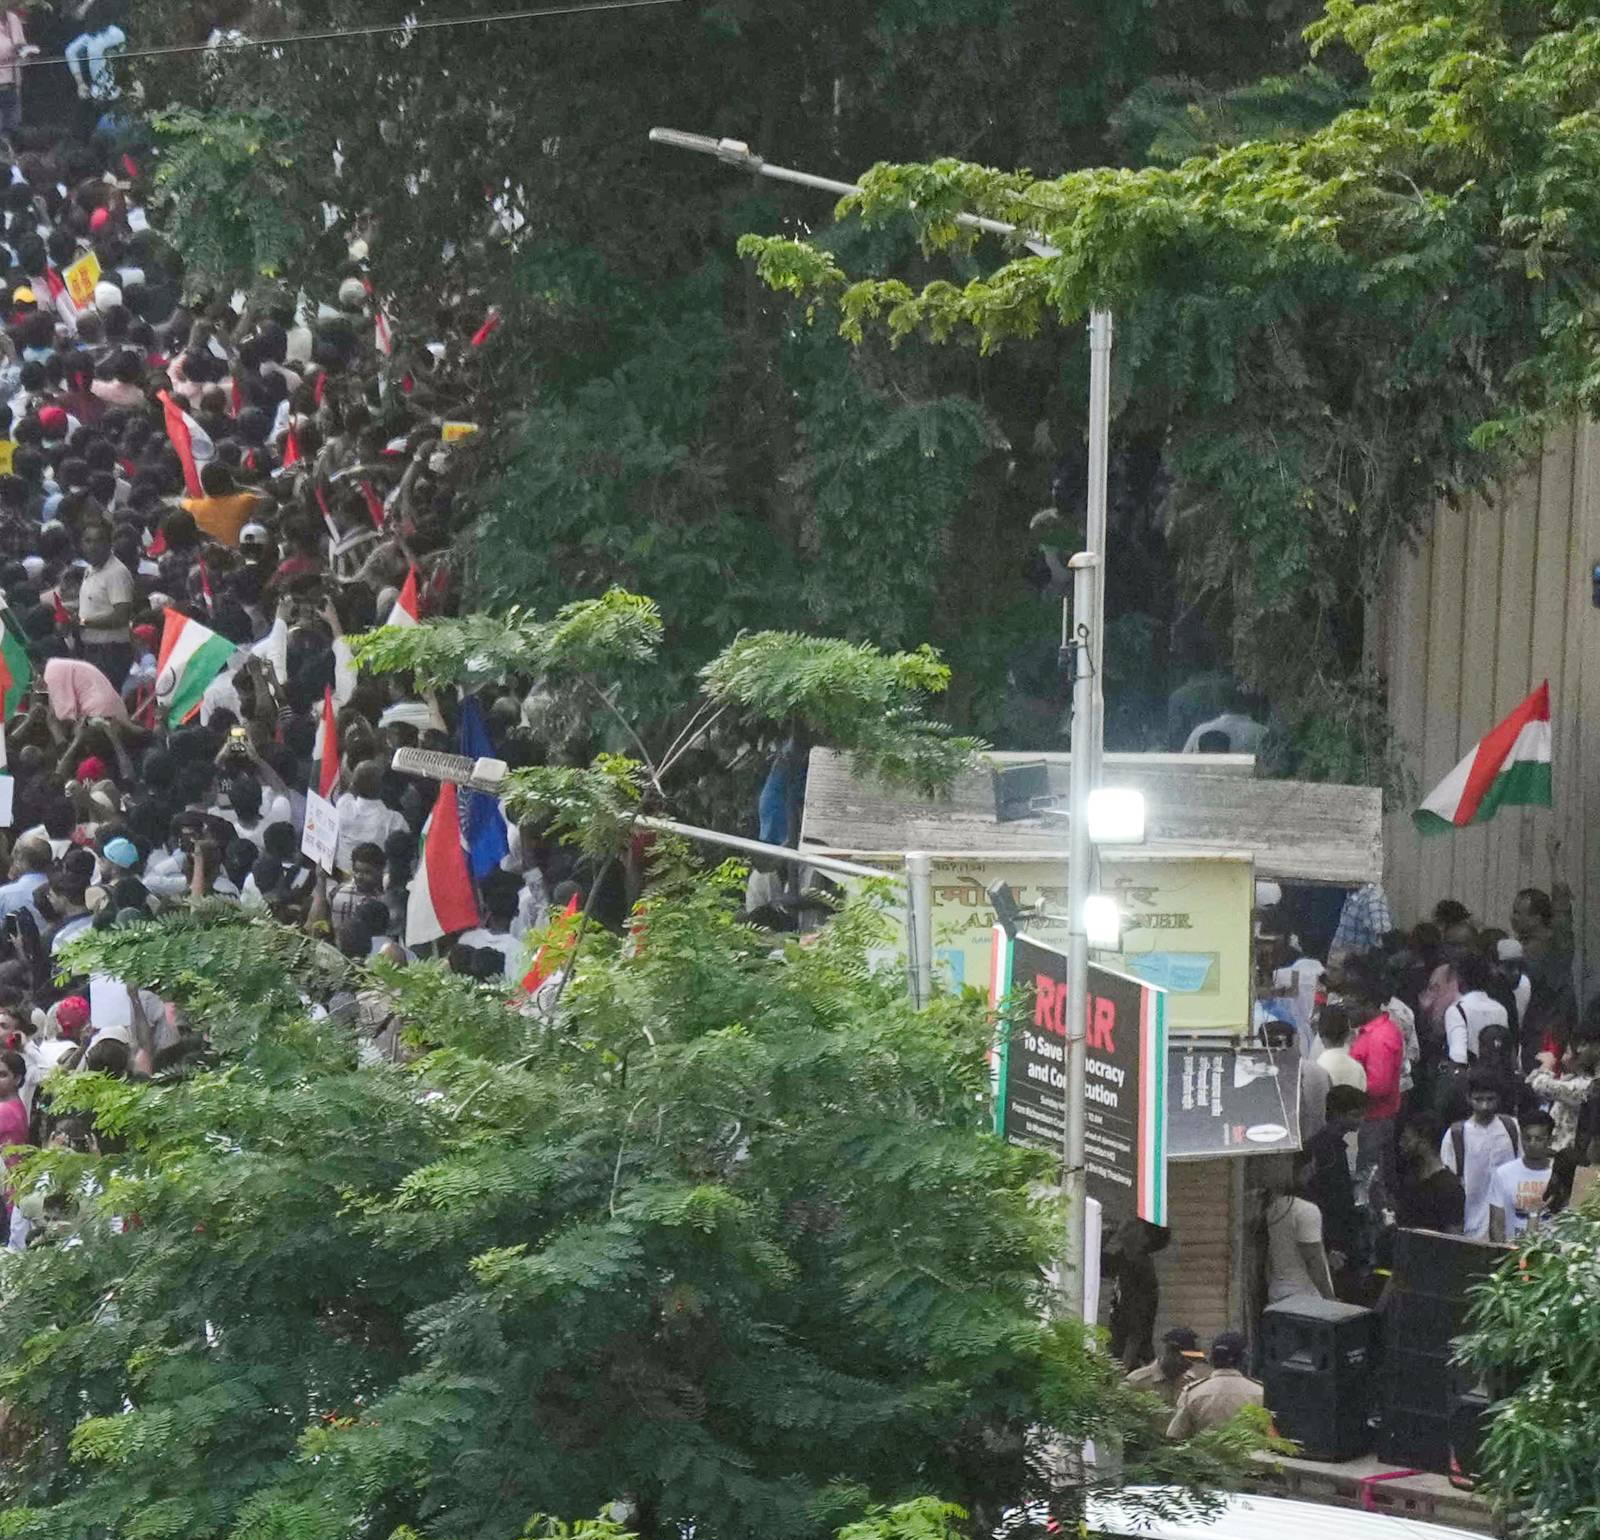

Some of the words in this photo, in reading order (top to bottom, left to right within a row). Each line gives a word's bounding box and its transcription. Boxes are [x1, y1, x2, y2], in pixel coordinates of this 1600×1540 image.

[1023, 1030, 1036, 1051] To
[1037, 1036, 1064, 1062] Save
[1027, 1063, 1049, 1082] and
